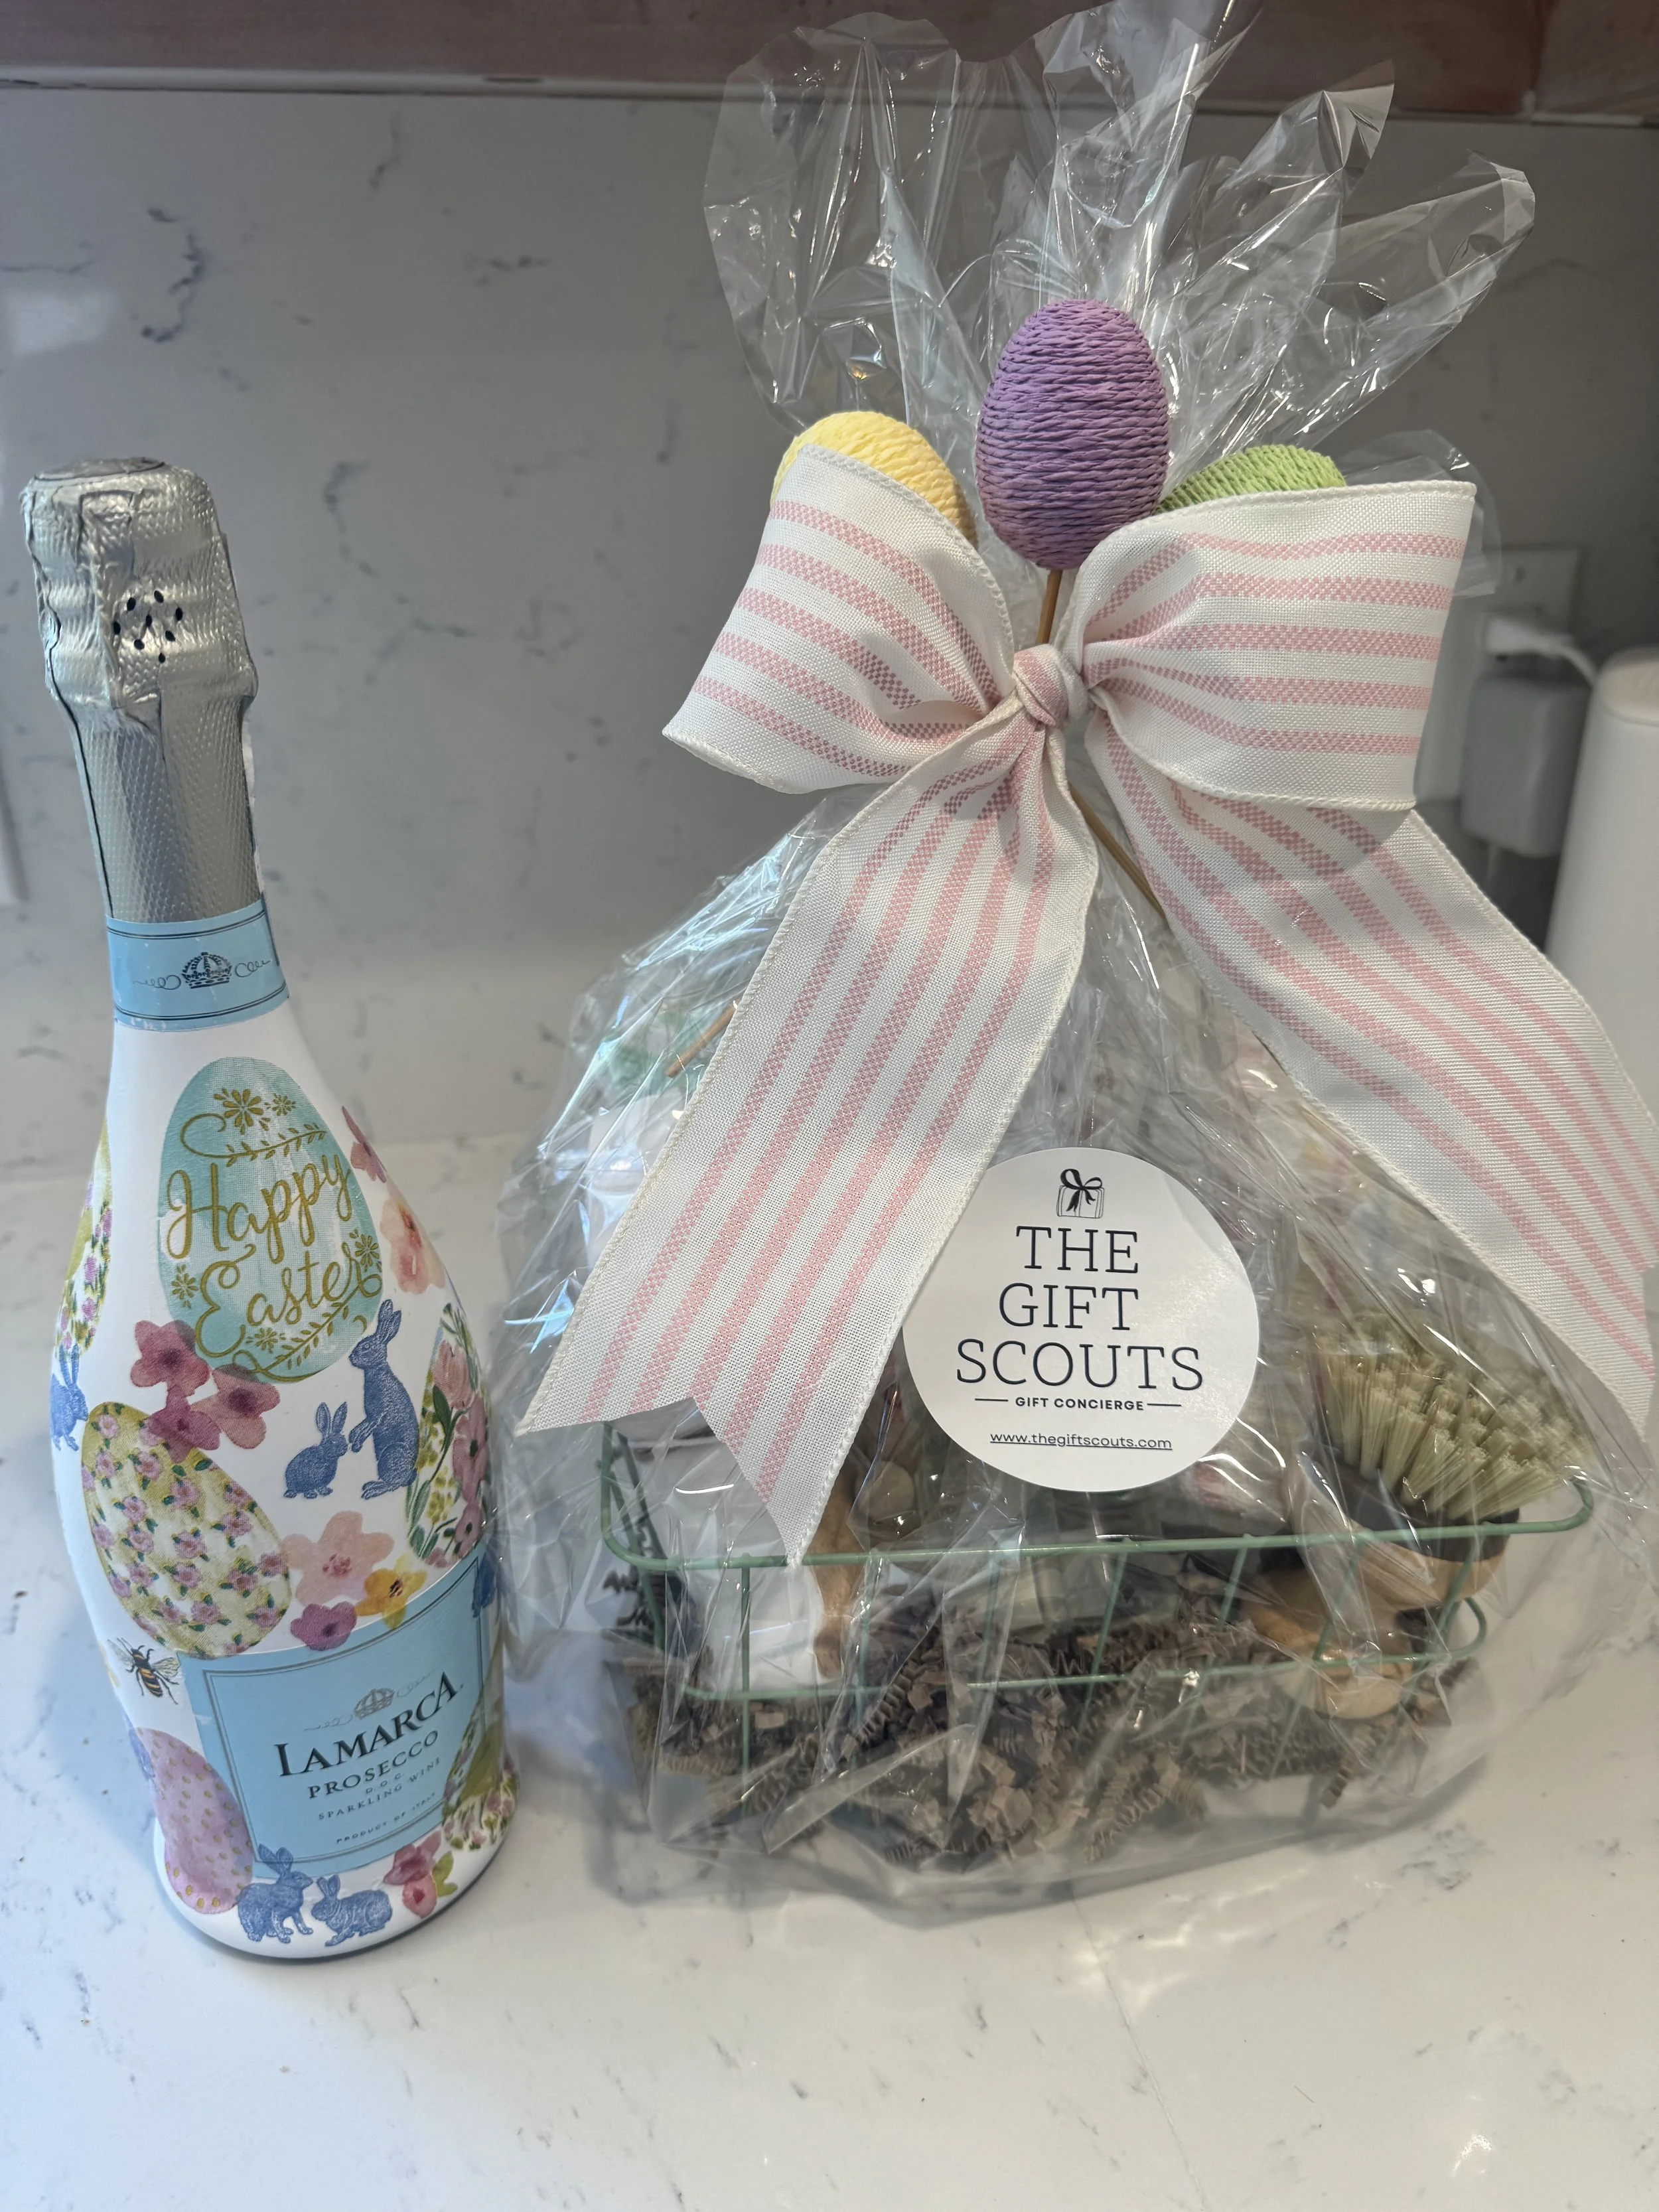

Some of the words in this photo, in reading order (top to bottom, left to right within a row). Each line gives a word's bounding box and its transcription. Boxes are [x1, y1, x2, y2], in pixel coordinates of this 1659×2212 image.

[167, 1153, 352, 1263] Happy
[1016, 1225, 1139, 1274] THE
[195, 1244, 383, 1357] Easter
[999, 1283, 1139, 1331] GIFT
[956, 1339, 1203, 1391] SCOUTS
[1015, 1396, 1048, 1408] GIFT
[1054, 1398, 1144, 1410] CONCIERGE
[989, 1432, 1173, 1449] www.thegiftscouts.com
[308, 1730, 439, 1799] PROSECCO
[318, 1784, 402, 1820] SPARKLING
[409, 1757, 441, 1783] WINE
[336, 1821, 387, 1844] PRODUCT
